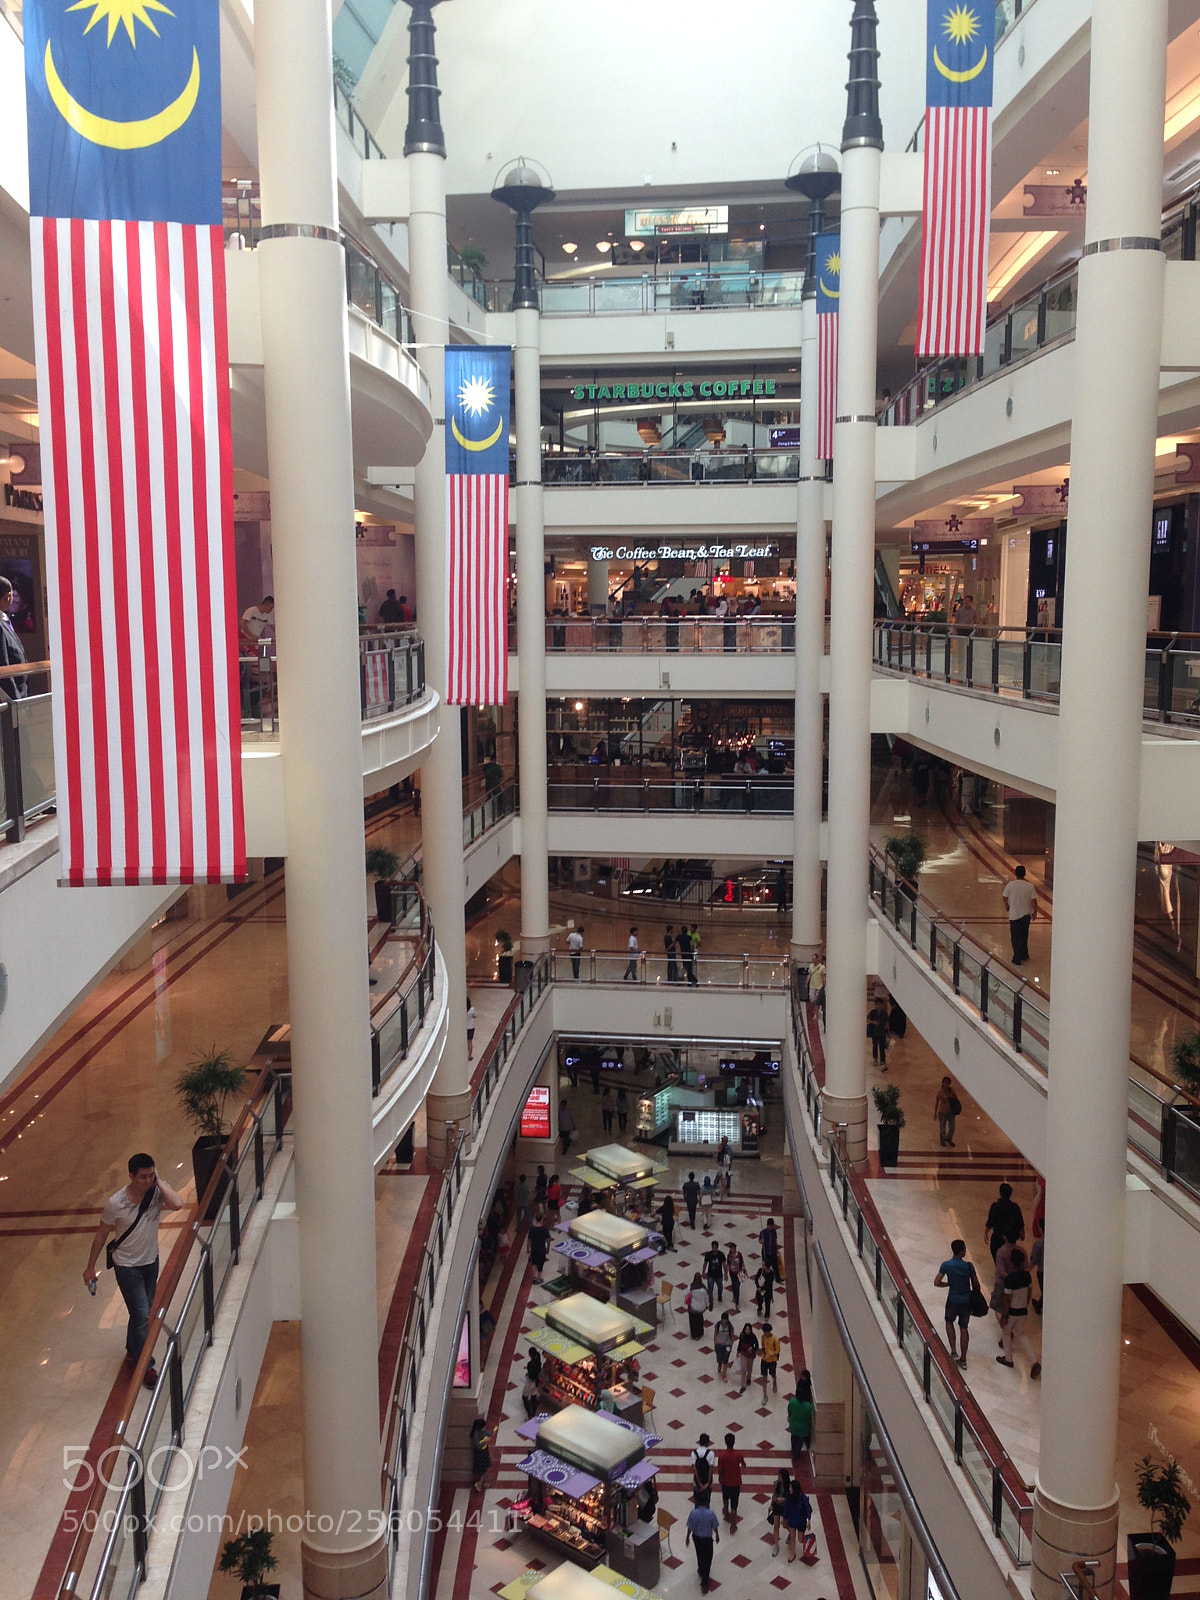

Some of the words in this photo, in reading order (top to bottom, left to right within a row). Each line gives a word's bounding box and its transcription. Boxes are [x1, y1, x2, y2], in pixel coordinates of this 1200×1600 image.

[574, 382, 694, 400] STARBUCKS
[700, 379, 776, 396] COFFEE
[772, 430, 779, 439] 4
[1157, 520, 1168, 539] GAP
[970, 540, 977, 549] 2
[591, 546, 613, 561] The
[616, 545, 656, 560] Coffee
[658, 545, 696, 560] Bean
[694, 545, 709, 558] &
[709, 545, 734, 558] Tea
[565, 1057, 573, 1066] C
[771, 1061, 779, 1071] C
